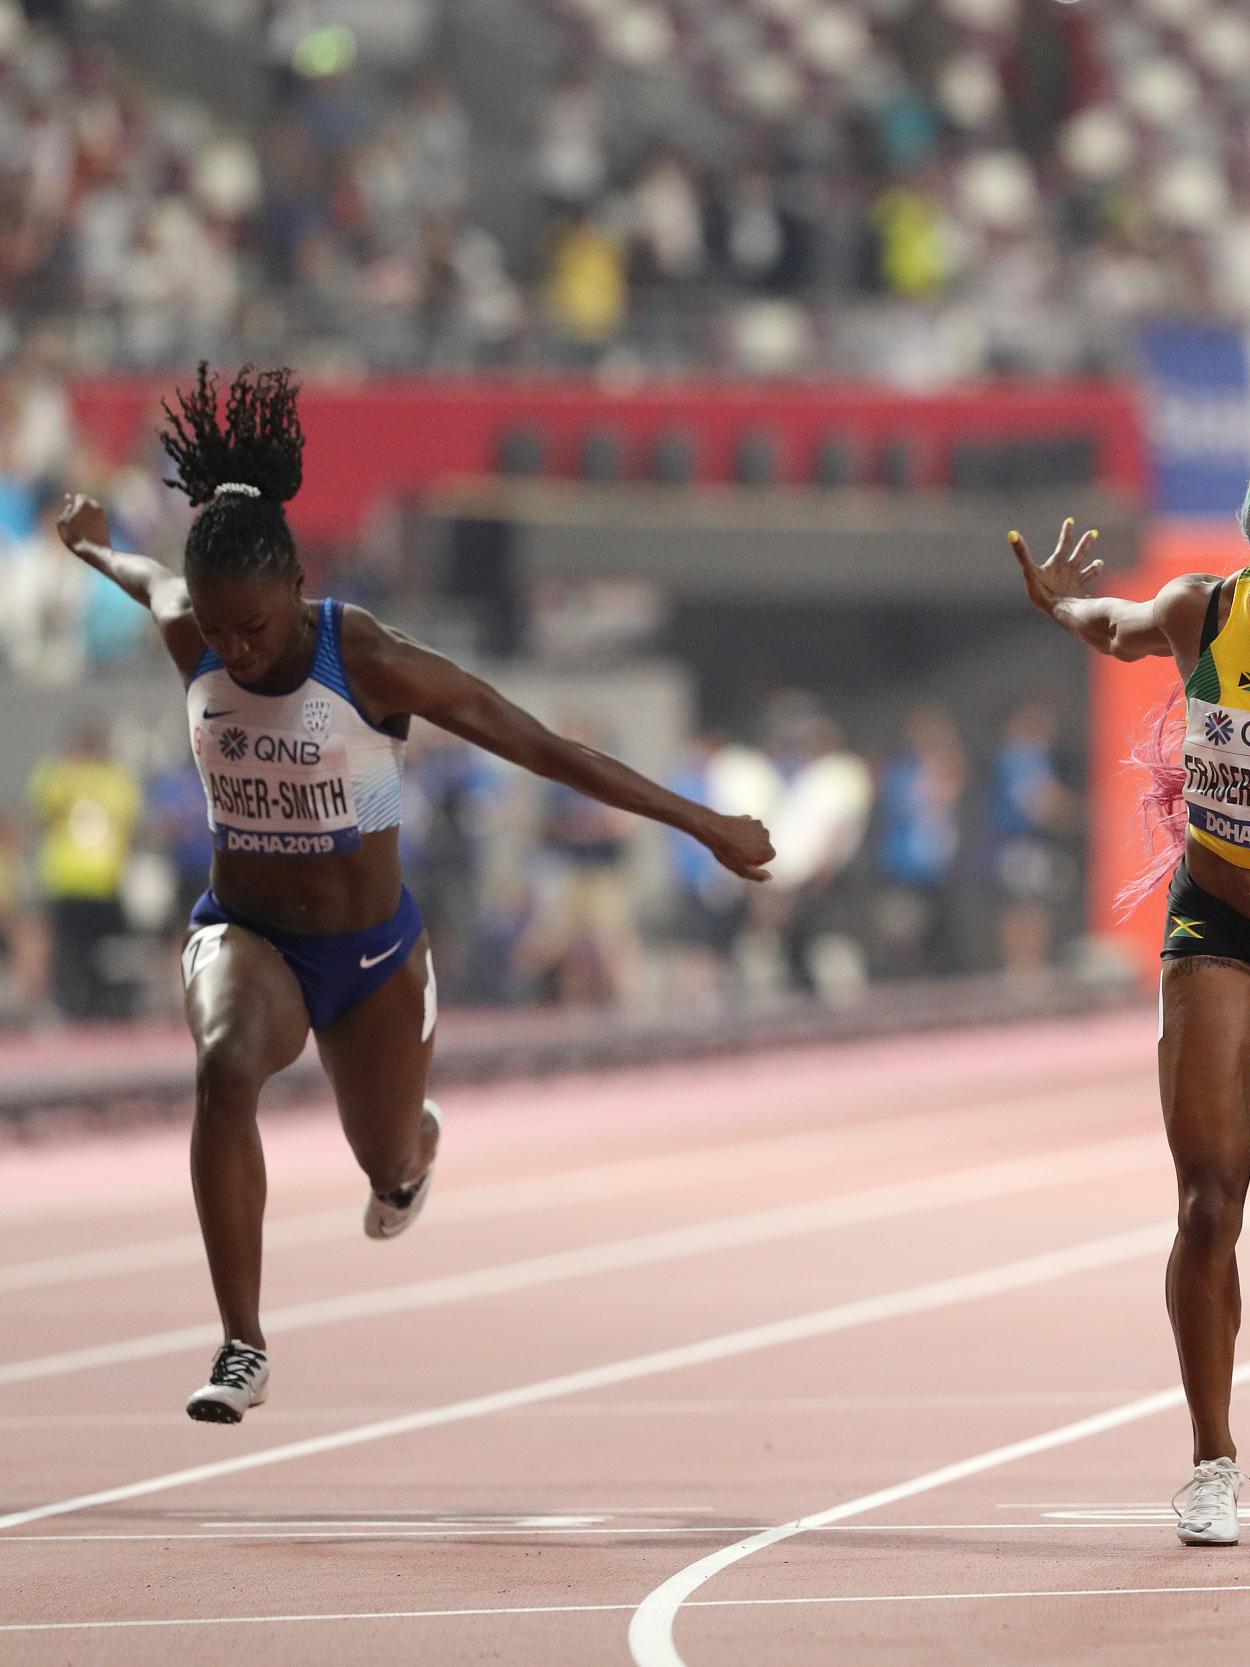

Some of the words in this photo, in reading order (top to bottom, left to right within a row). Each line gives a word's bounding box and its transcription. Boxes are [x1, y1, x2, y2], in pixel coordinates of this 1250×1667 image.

[254, 735, 321, 766] QNB
[210, 772, 348, 821] ASHER-SMITH
[227, 831, 335, 854] DOHA2019
